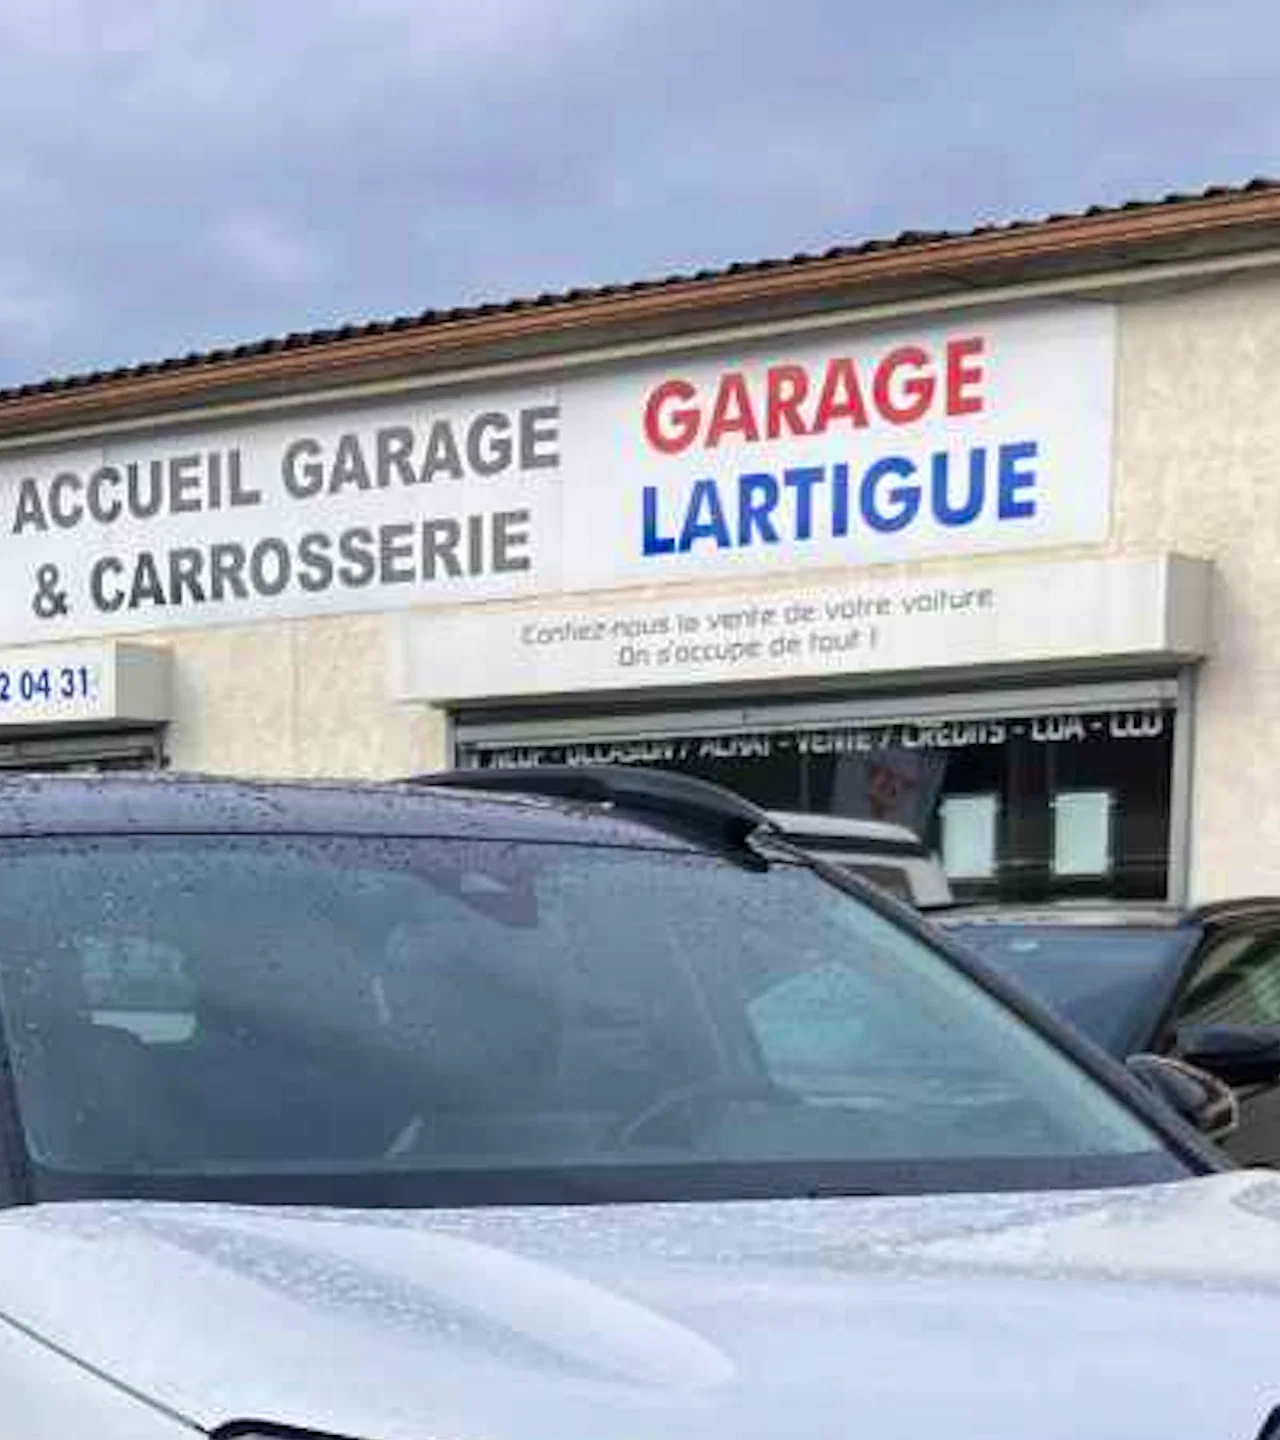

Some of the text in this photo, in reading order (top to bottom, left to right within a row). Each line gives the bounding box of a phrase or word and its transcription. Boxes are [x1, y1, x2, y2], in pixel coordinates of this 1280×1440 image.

[644, 337, 985, 454] GARAGE
[13, 406, 560, 534] ACCUEIL GARAGE
[642, 442, 1038, 556] LARTIGUE
[32, 509, 531, 618] & CARROSSERIE
[709, 606, 774, 630] vente
[783, 606, 816, 624] de
[825, 596, 891, 619] votre
[902, 588, 993, 614] voiture
[21, 668, 51, 700] 04
[61, 666, 88, 697] 31
[619, 645, 651, 666] On
[770, 635, 802, 656] de
[810, 629, 861, 653] tout
